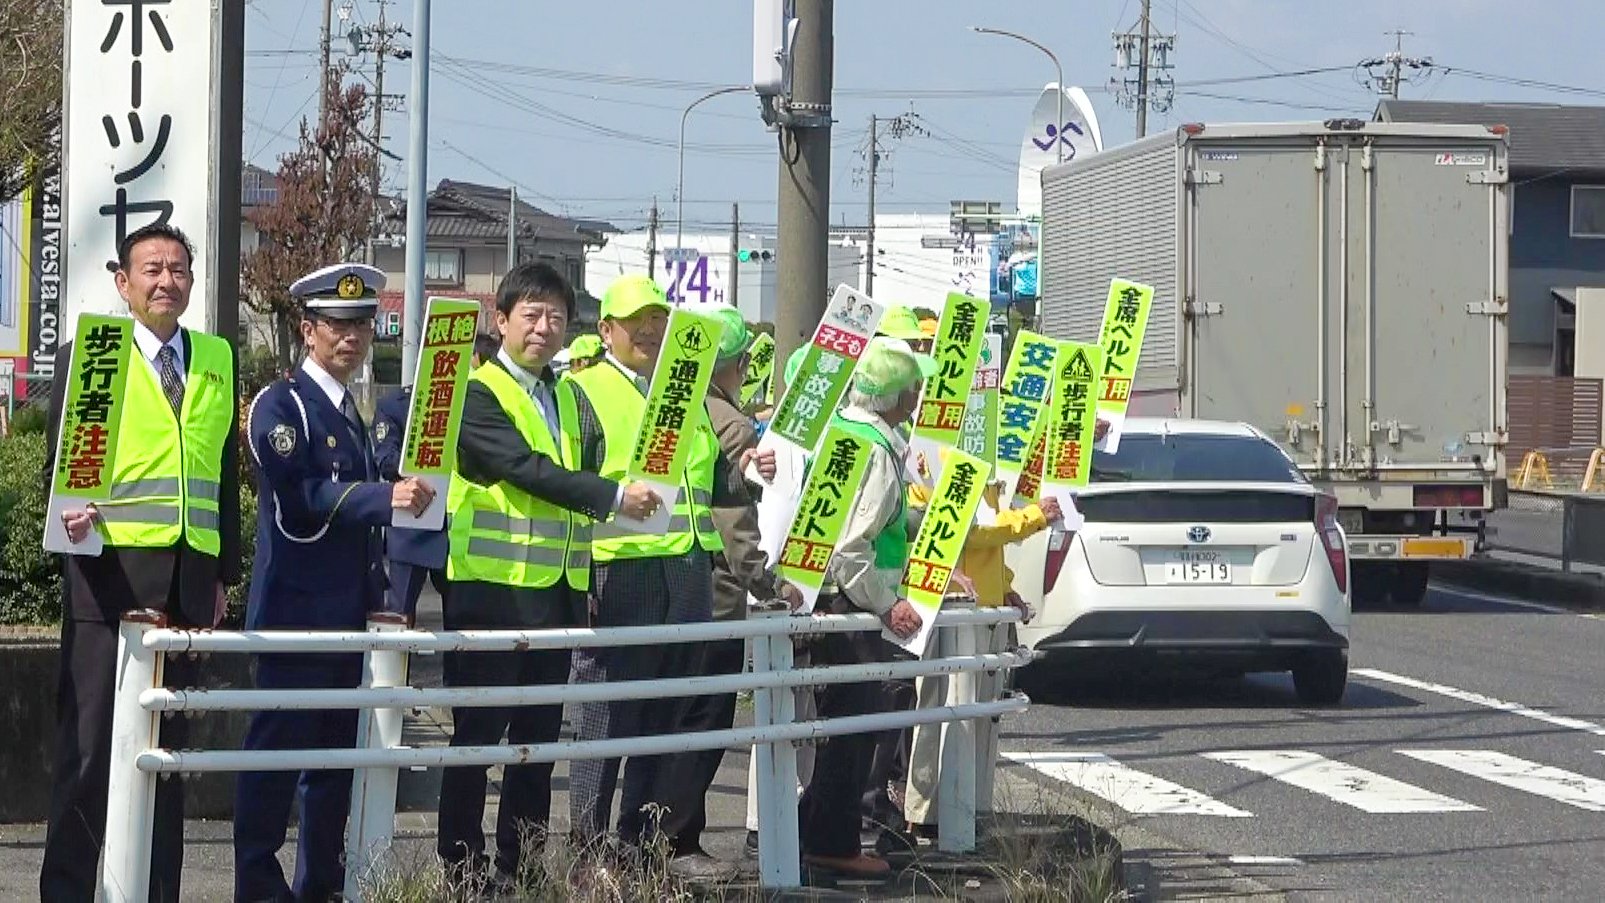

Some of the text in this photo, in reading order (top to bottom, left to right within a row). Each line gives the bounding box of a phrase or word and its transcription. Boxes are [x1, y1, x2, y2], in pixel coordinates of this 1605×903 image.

[427, 313, 476, 345] 根絶
[819, 326, 863, 356] 子ども
[935, 301, 979, 399] 全席ベルト
[1104, 286, 1143, 375] 全席ベルト
[65, 324, 123, 489] 歩行者注意
[415, 350, 460, 469] 飲酒運転
[642, 358, 699, 475] 通学路注意
[781, 351, 845, 441] 事故防止
[917, 403, 963, 429] 着用
[997, 342, 1057, 463] 交通安全
[1054, 384, 1088, 480] 歩行者注意
[803, 438, 861, 538] 全席ベルト
[924, 462, 978, 559] 全席ベルト
[783, 540, 831, 569] 着用
[905, 562, 950, 592] 着用
[1183, 563, 1228, 580] 15-19
